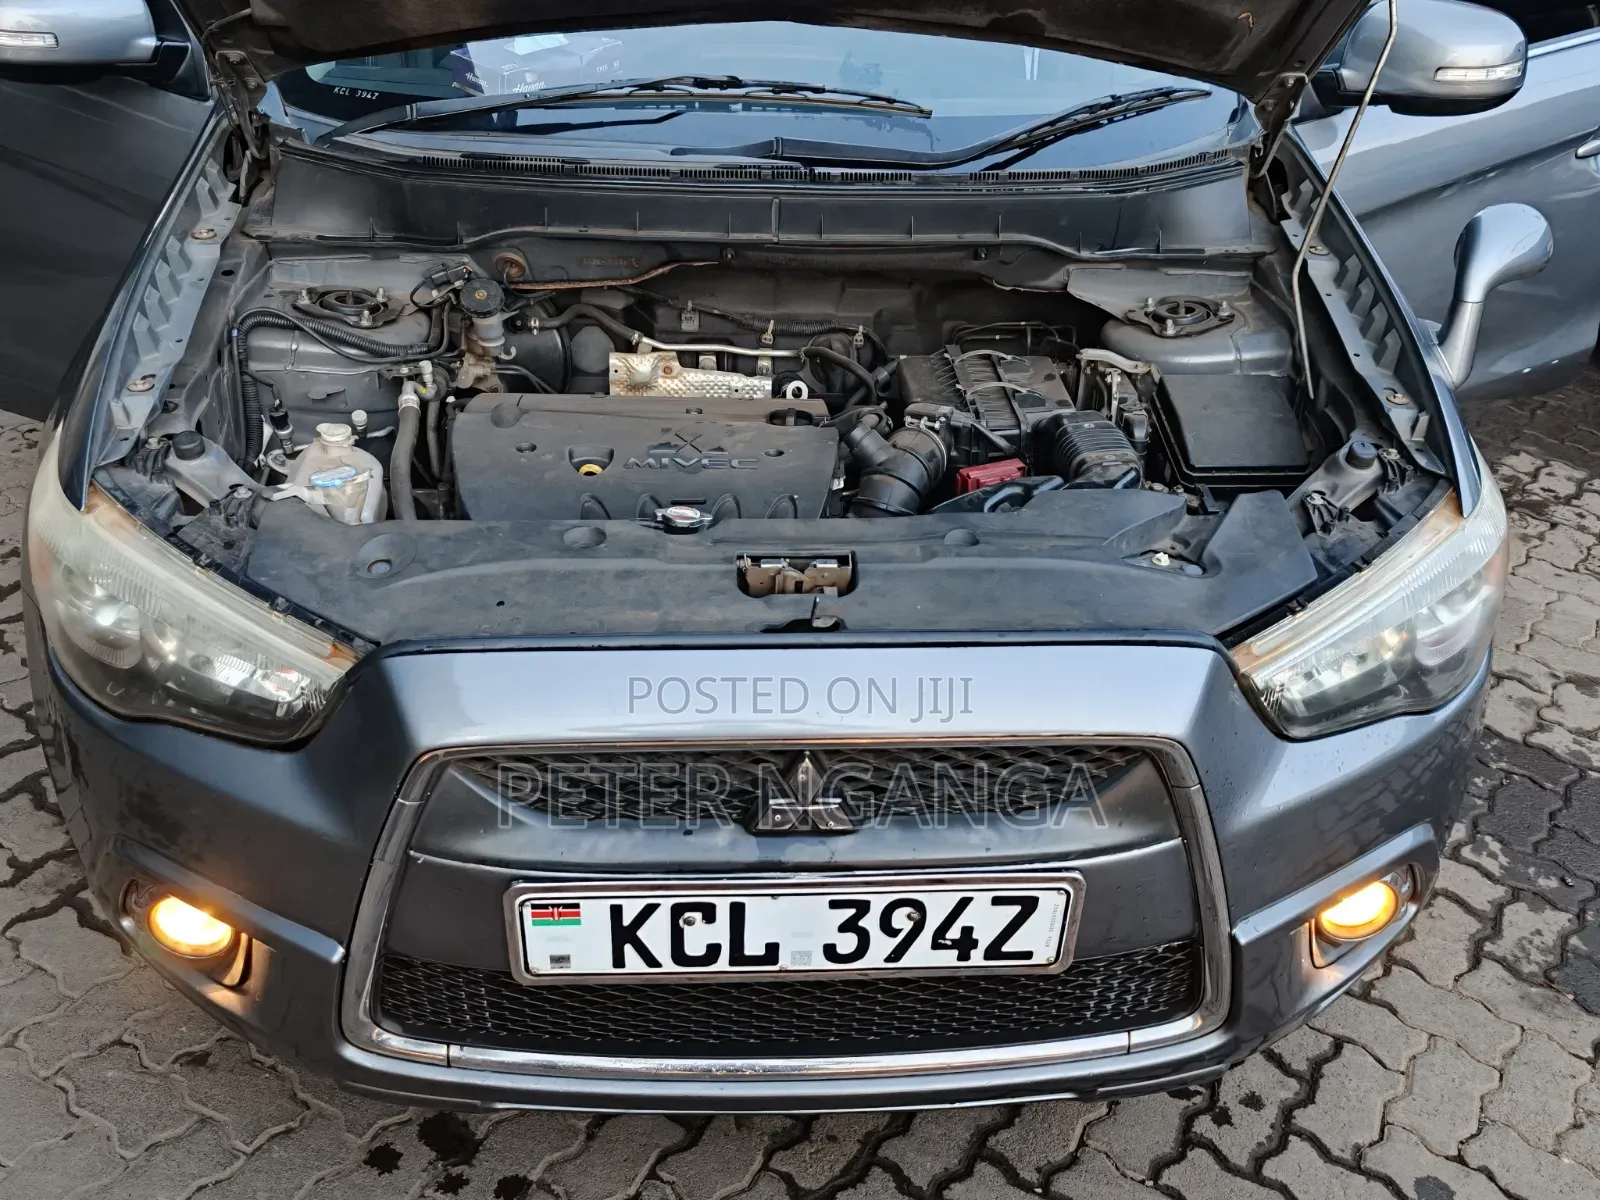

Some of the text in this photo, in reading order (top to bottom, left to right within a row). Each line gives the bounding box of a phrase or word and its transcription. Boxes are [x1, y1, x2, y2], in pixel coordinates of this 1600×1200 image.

[333, 86, 350, 96] KCL
[513, 81, 547, 94] Hanan
[623, 457, 759, 470] MIVEC
[610, 901, 780, 969] KCL
[822, 896, 1040, 964] 394Z
